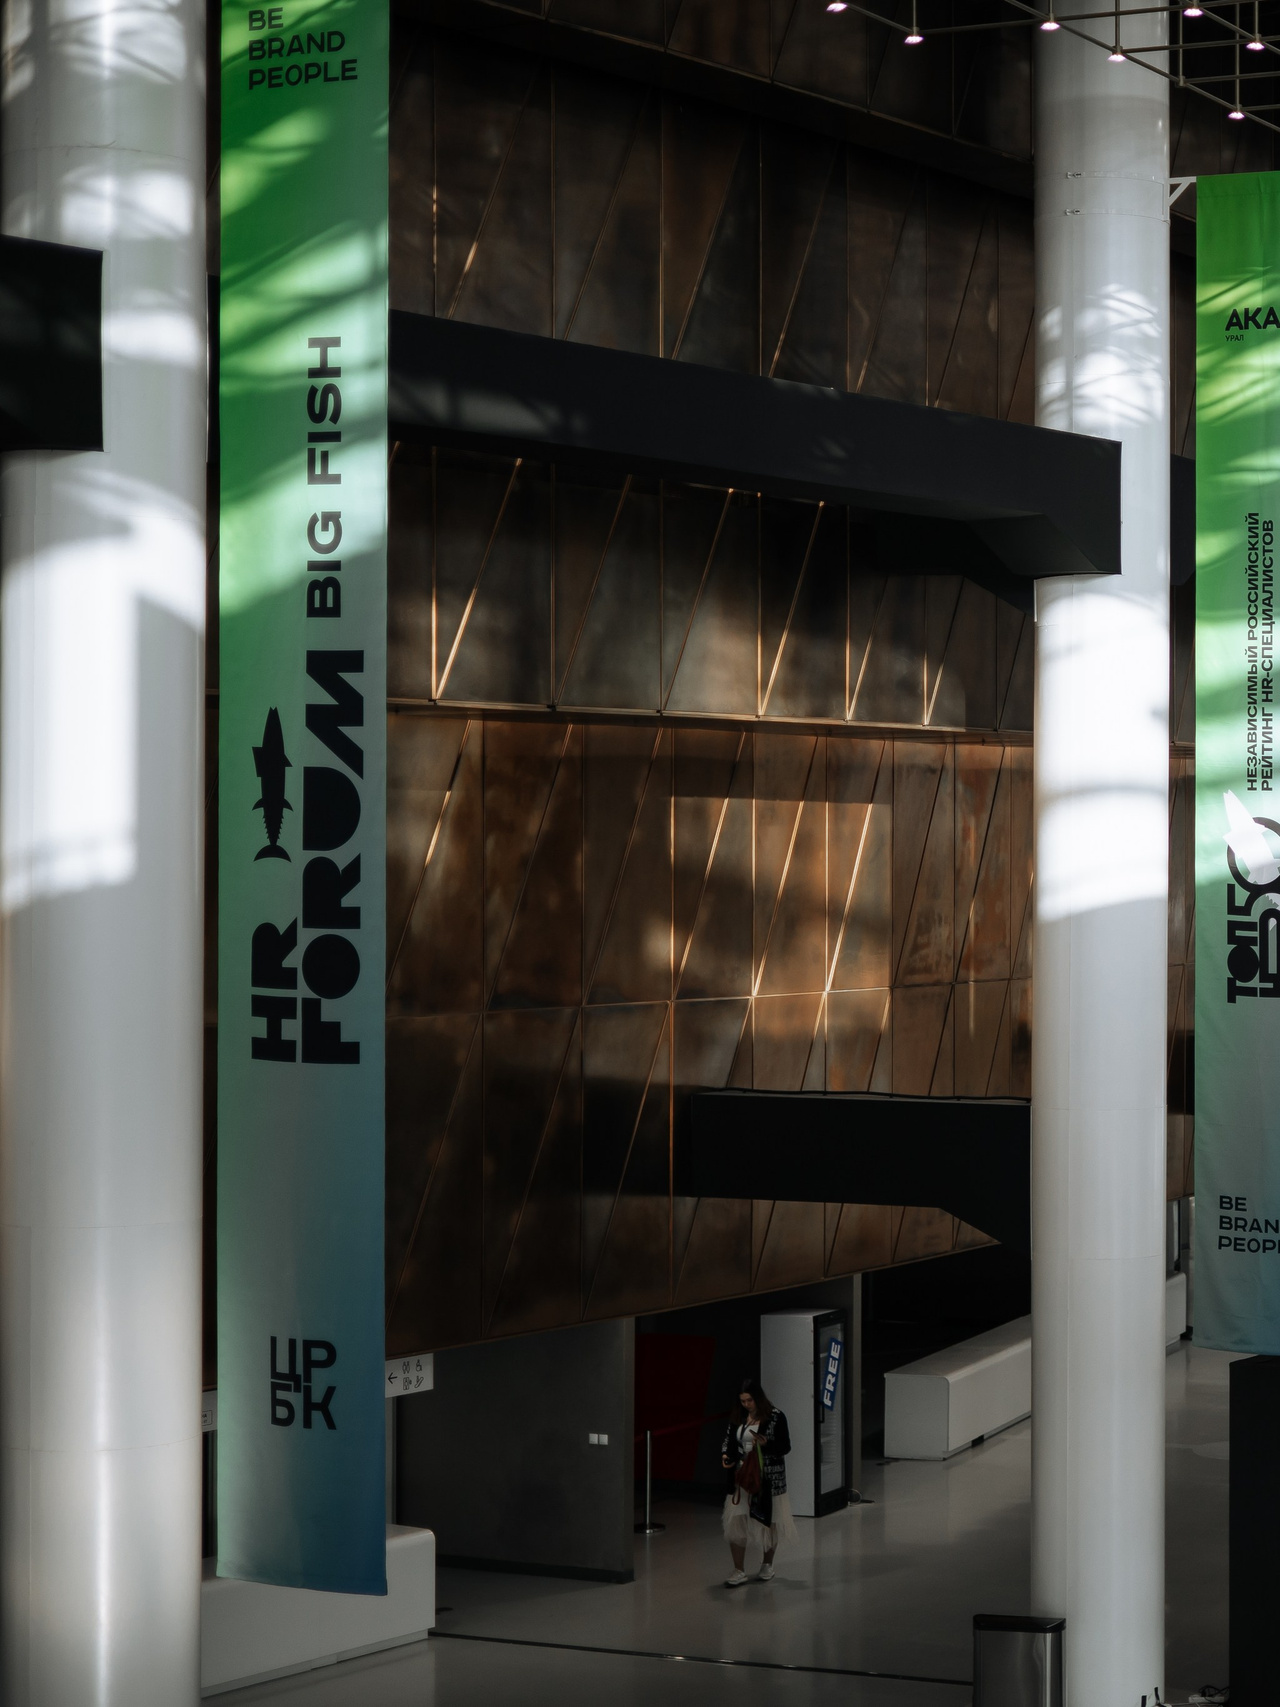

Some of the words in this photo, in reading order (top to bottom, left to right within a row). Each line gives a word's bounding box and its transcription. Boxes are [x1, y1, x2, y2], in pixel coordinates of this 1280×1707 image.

[248, 7, 283, 31] BE
[248, 31, 345, 60] BRAND
[249, 59, 358, 90] PEOPLE
[307, 336, 341, 486] FISH
[307, 511, 342, 618] BIG
[1245, 513, 1259, 641] РОССИЙСКИЙ
[1261, 520, 1275, 703] HR-СПЕЦИАЛИСТОВ
[1245, 646, 1259, 792] НЕЗАВИСИМЫЙ
[1258, 707, 1274, 792] РЕЙТИНГ
[302, 650, 364, 1064] FORUM
[252, 916, 298, 1063] HR
[1219, 1195, 1247, 1211] BE
[823, 1342, 841, 1407] FREE
